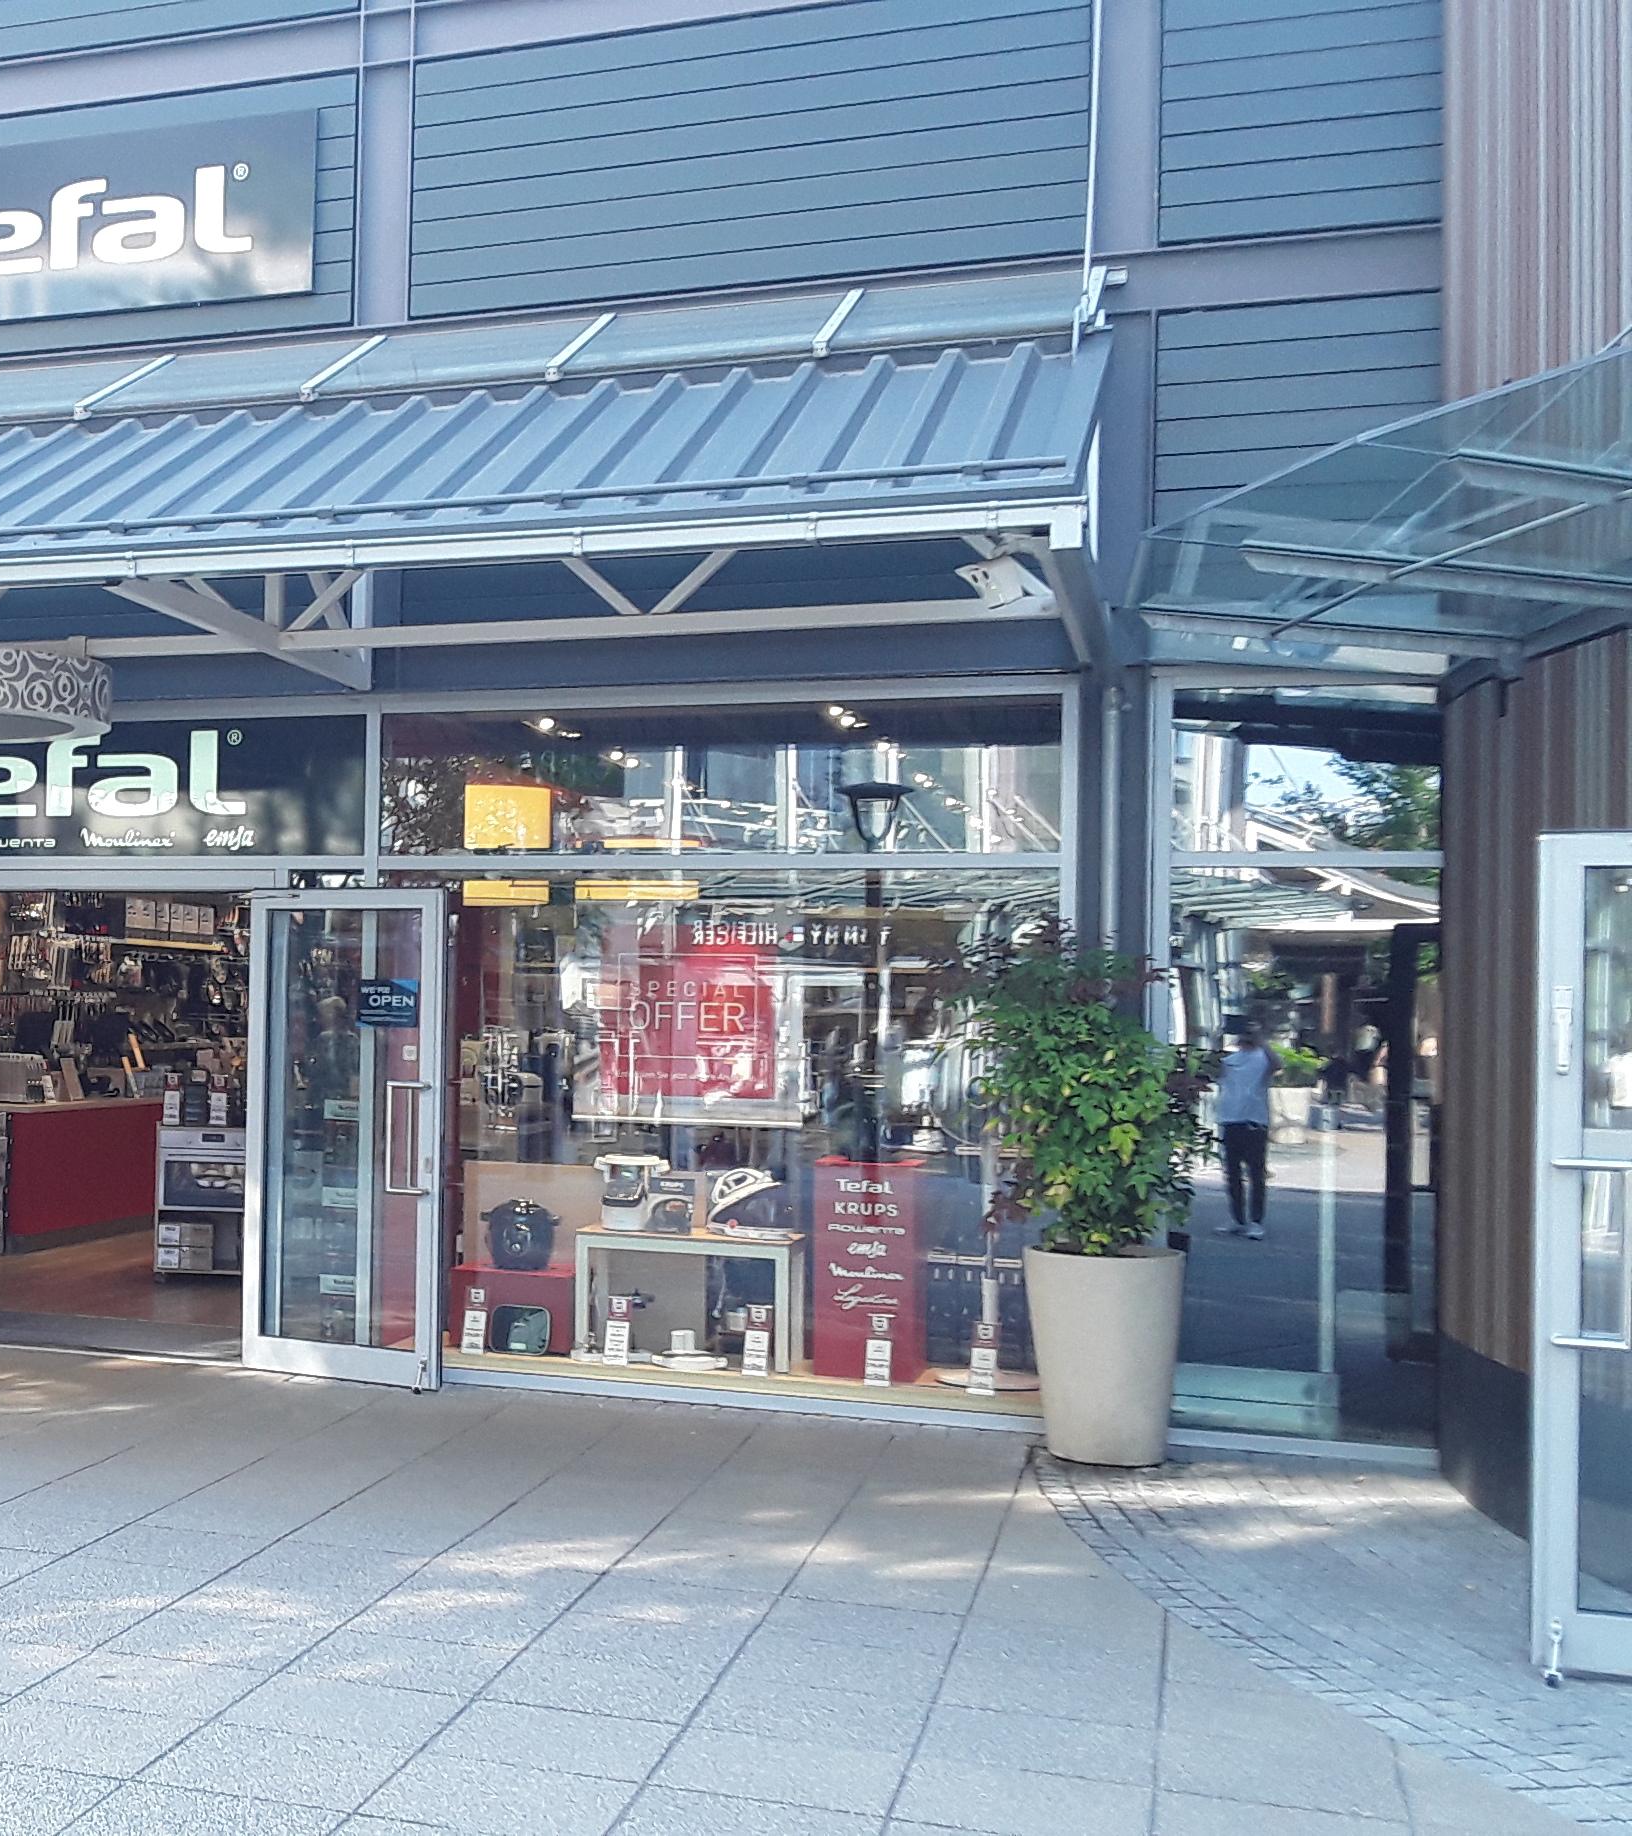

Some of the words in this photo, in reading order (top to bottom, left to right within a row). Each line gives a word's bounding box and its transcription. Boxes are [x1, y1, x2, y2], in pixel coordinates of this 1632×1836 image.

[80, 828, 175, 848] Moulinex
[629, 981, 745, 997] SPECIAL
[368, 994, 414, 1007] OPEN
[629, 1001, 746, 1032] OFFER
[835, 1178, 894, 1195] Tefal
[834, 1201, 899, 1217] KRUPS
